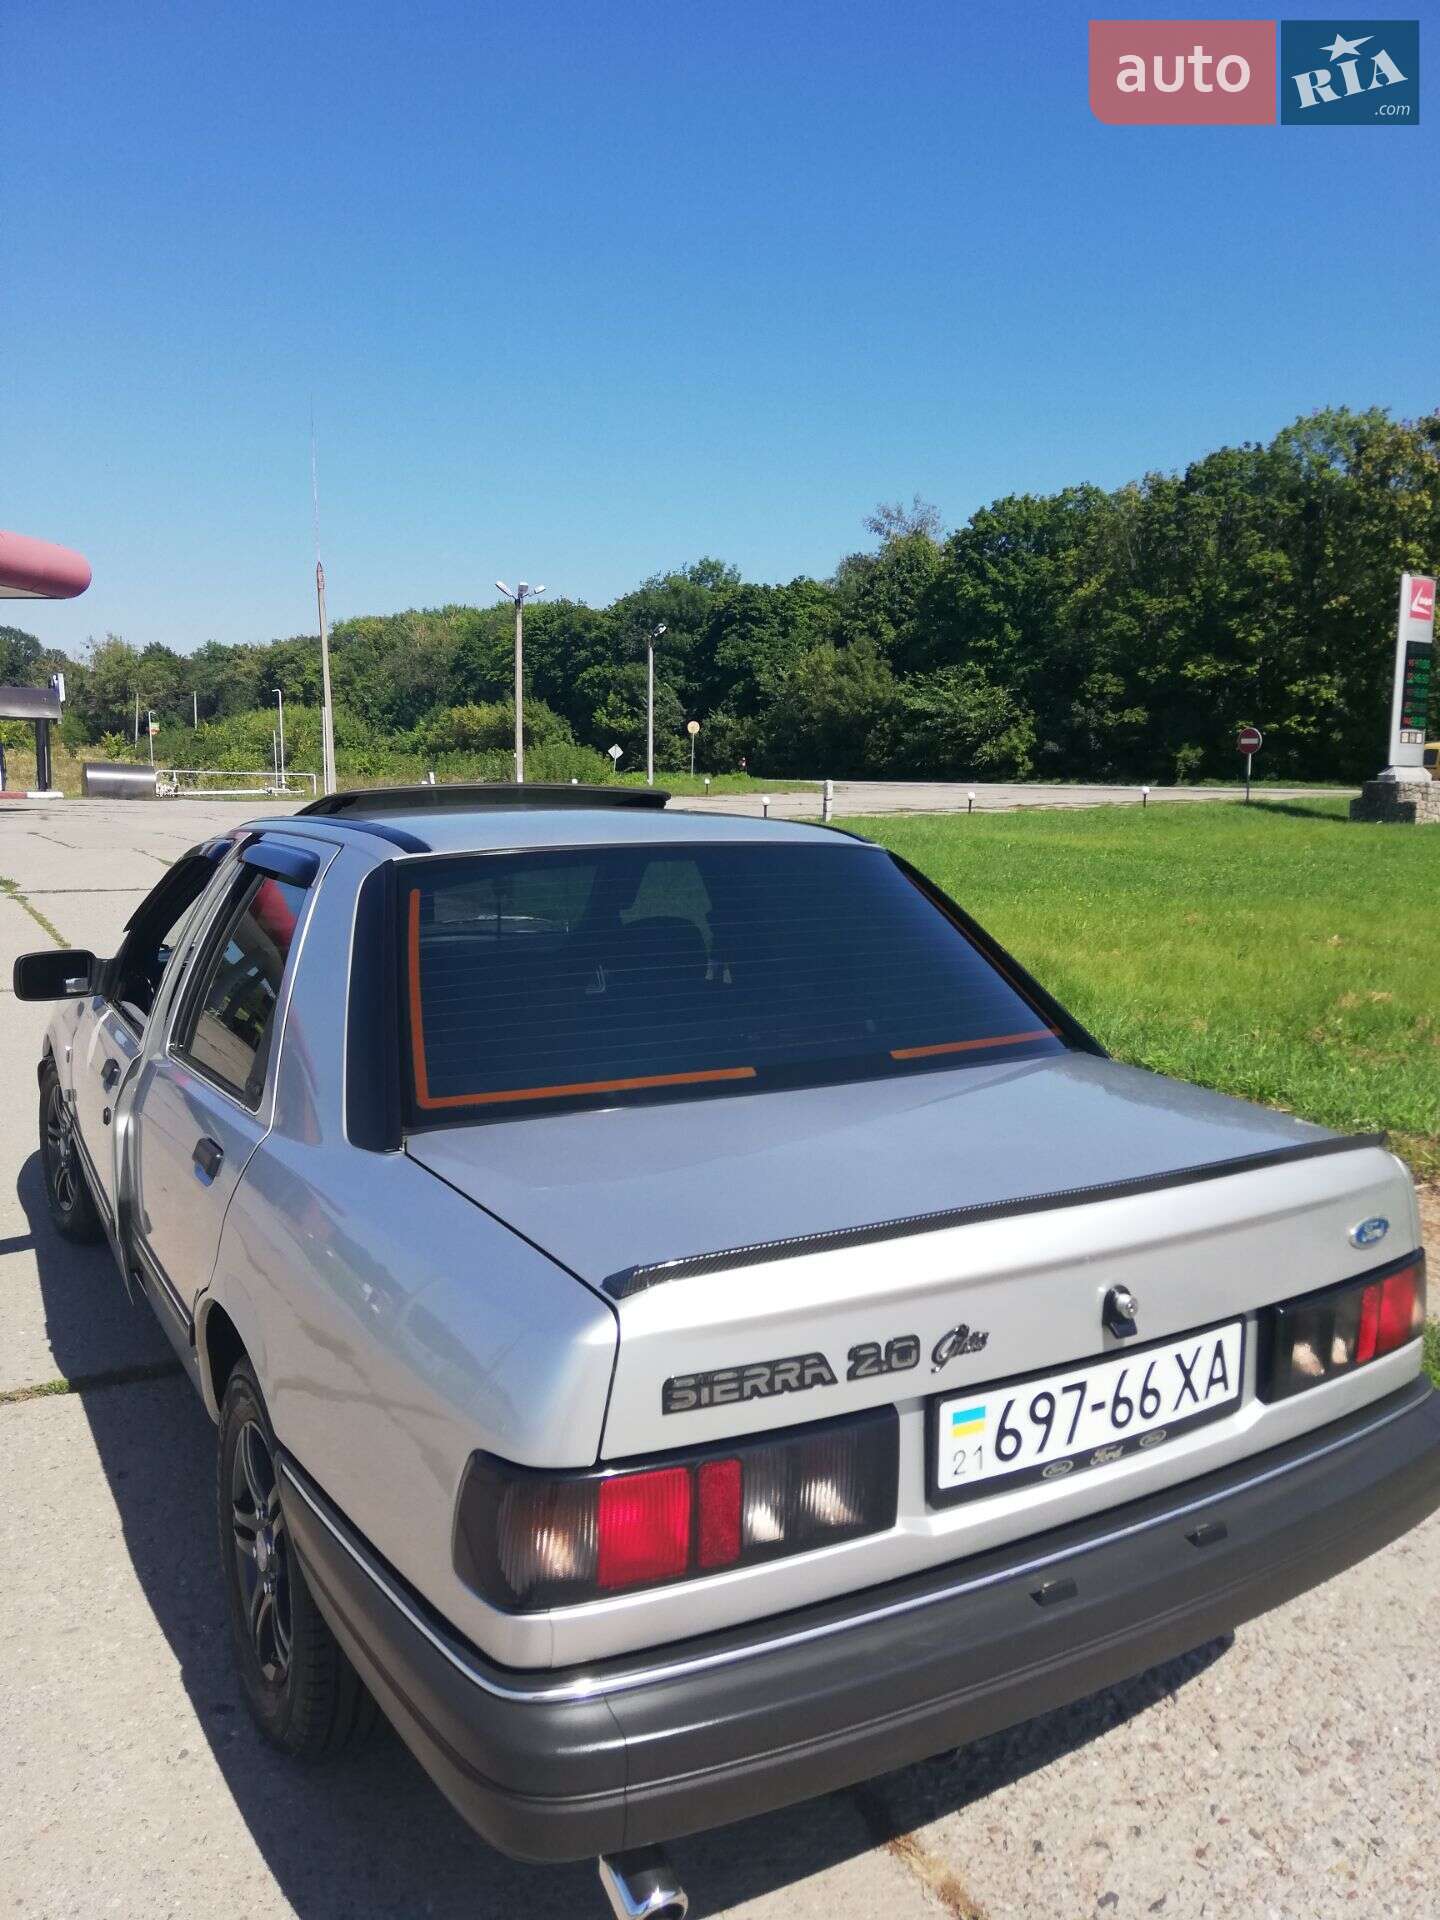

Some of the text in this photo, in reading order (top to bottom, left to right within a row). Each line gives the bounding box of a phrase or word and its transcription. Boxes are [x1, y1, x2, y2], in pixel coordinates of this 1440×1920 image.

[662, 1352, 839, 1415] SIERRA
[847, 1334, 921, 1381] 2.0
[952, 1445, 984, 1477] 21
